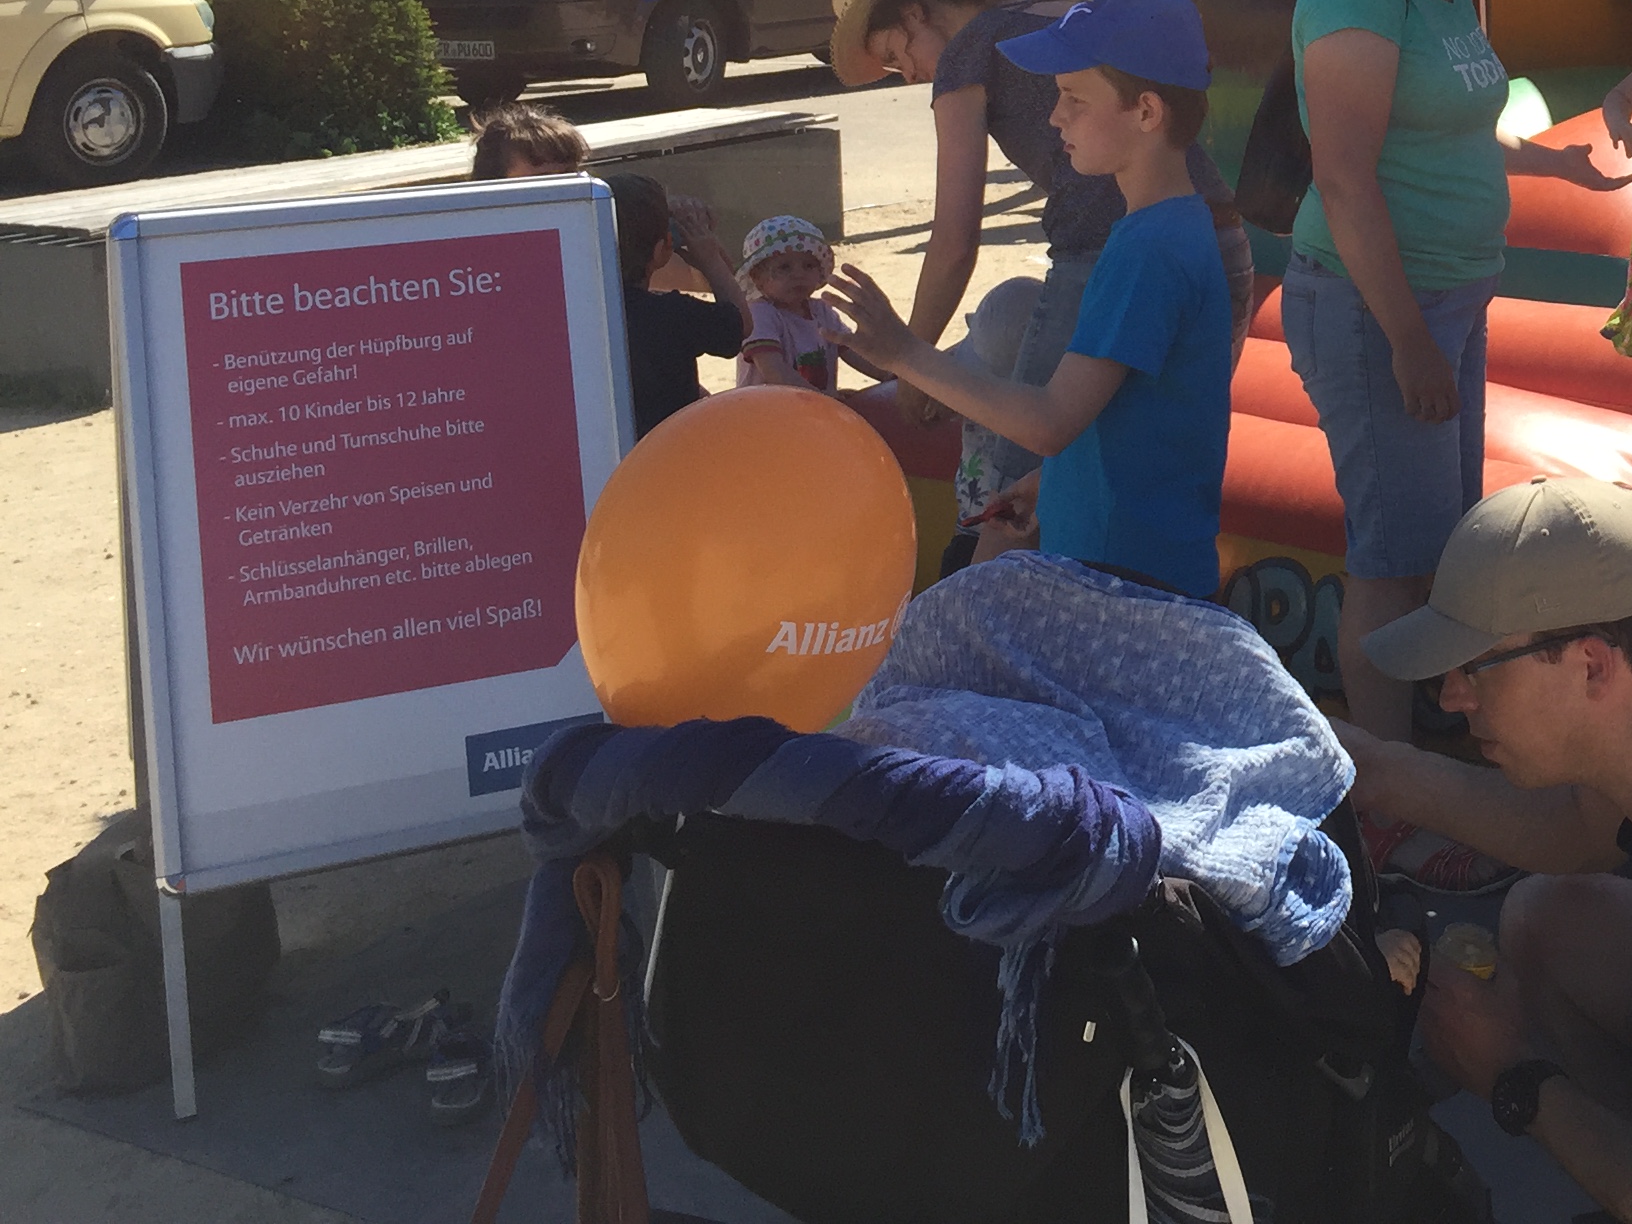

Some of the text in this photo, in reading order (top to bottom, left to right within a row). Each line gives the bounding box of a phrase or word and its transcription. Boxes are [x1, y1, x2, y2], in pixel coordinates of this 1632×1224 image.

[1442, 37, 1470, 61] NO
[209, 266, 502, 321] Bitte beachten Sie:
[224, 346, 321, 371] Benützung
[326, 342, 355, 359] der
[359, 333, 442, 356] Hüpfburg
[446, 327, 474, 346] auf
[227, 364, 358, 395] eigene Gefahr!
[229, 409, 273, 429] max.
[279, 404, 301, 423] 10
[304, 397, 361, 419] Kinder
[367, 394, 391, 412] bis
[396, 390, 416, 408] 12
[420, 386, 466, 406] Jahre
[231, 440, 297, 464] Schuhe
[302, 435, 336, 454] und
[340, 422, 442, 449] Turnschuhe
[446, 418, 485, 436] bitte
[234, 462, 325, 487] ausziehen
[235, 504, 275, 523] Kein
[279, 491, 348, 516] Verzehr
[353, 489, 385, 507] von
[389, 479, 455, 504] Speisen
[460, 472, 493, 493] und
[238, 521, 333, 547] Getränken
[414, 535, 474, 557] Brillen,
[243, 550, 533, 607] Armbanduhren etc. bitte ablegen
[233, 599, 543, 665] Wir wünschen allen viel Spaß!
[766, 618, 890, 656] Allianz
[482, 747, 537, 773] Allia
